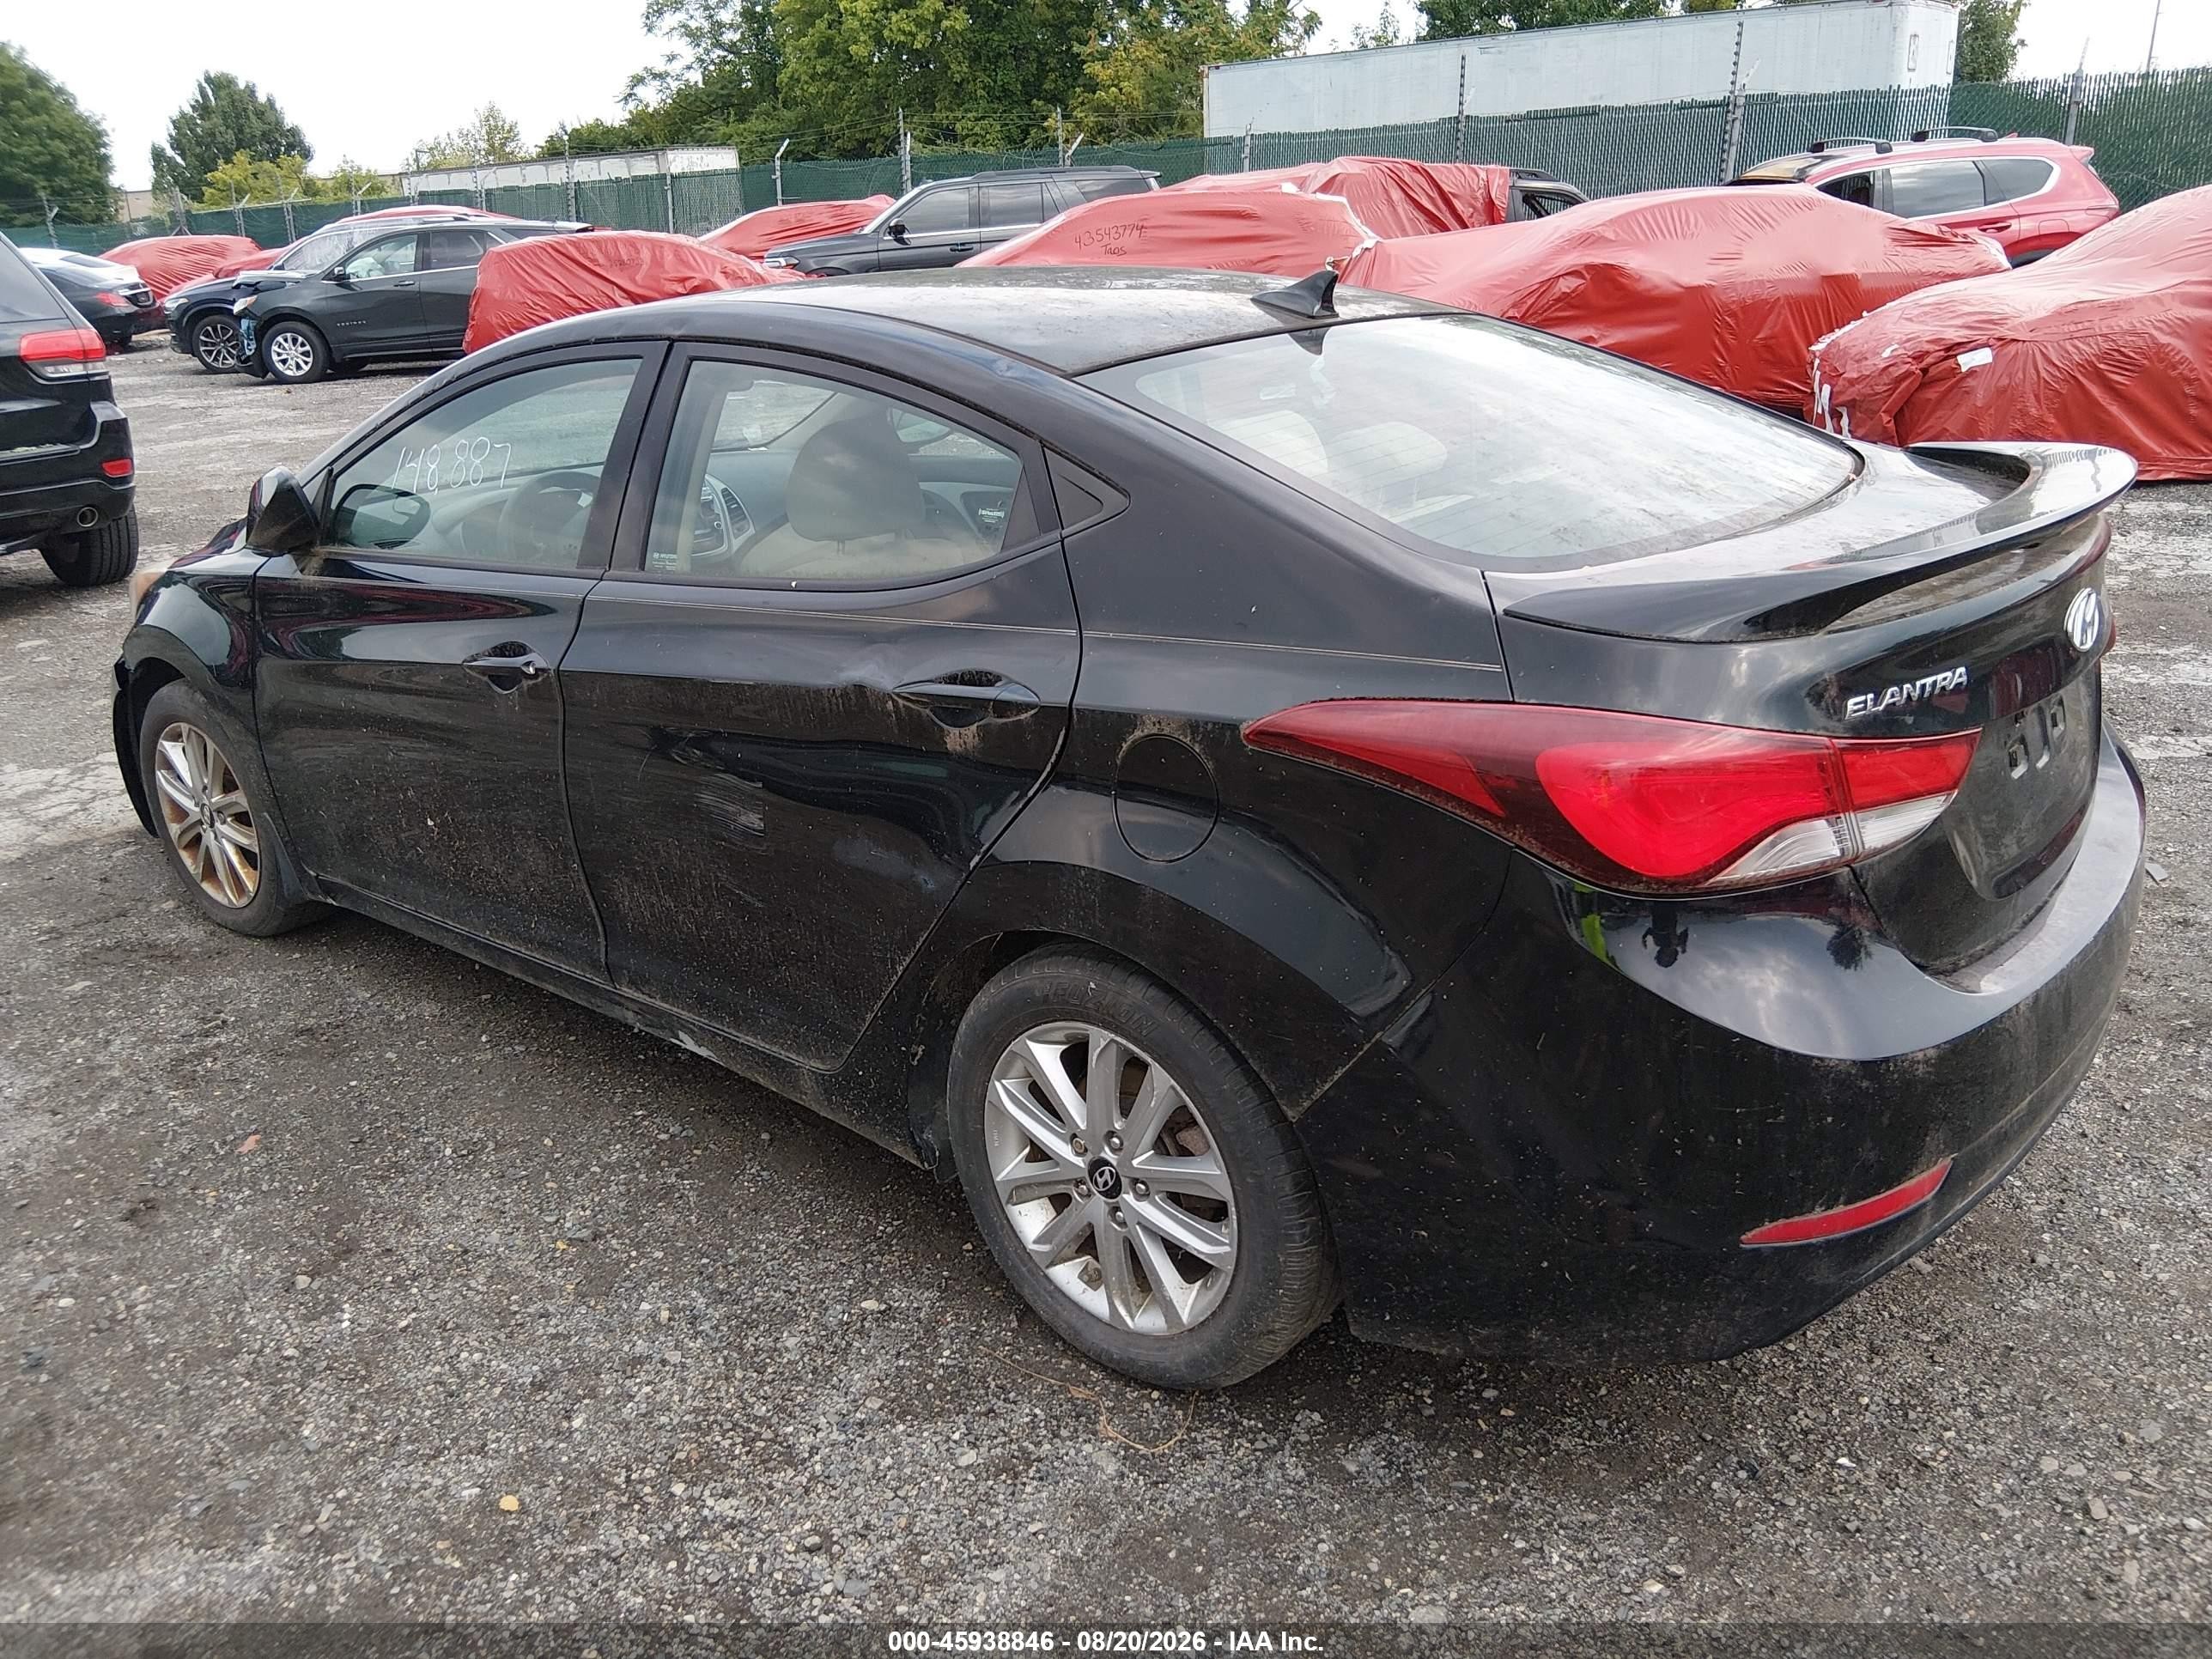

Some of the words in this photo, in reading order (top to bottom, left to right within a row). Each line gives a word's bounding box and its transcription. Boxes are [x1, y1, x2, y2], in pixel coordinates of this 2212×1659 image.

[1074, 222, 1146, 250] 43543774
[391, 436, 512, 495] 148,887
[1844, 666, 1968, 720] ELANTRA
